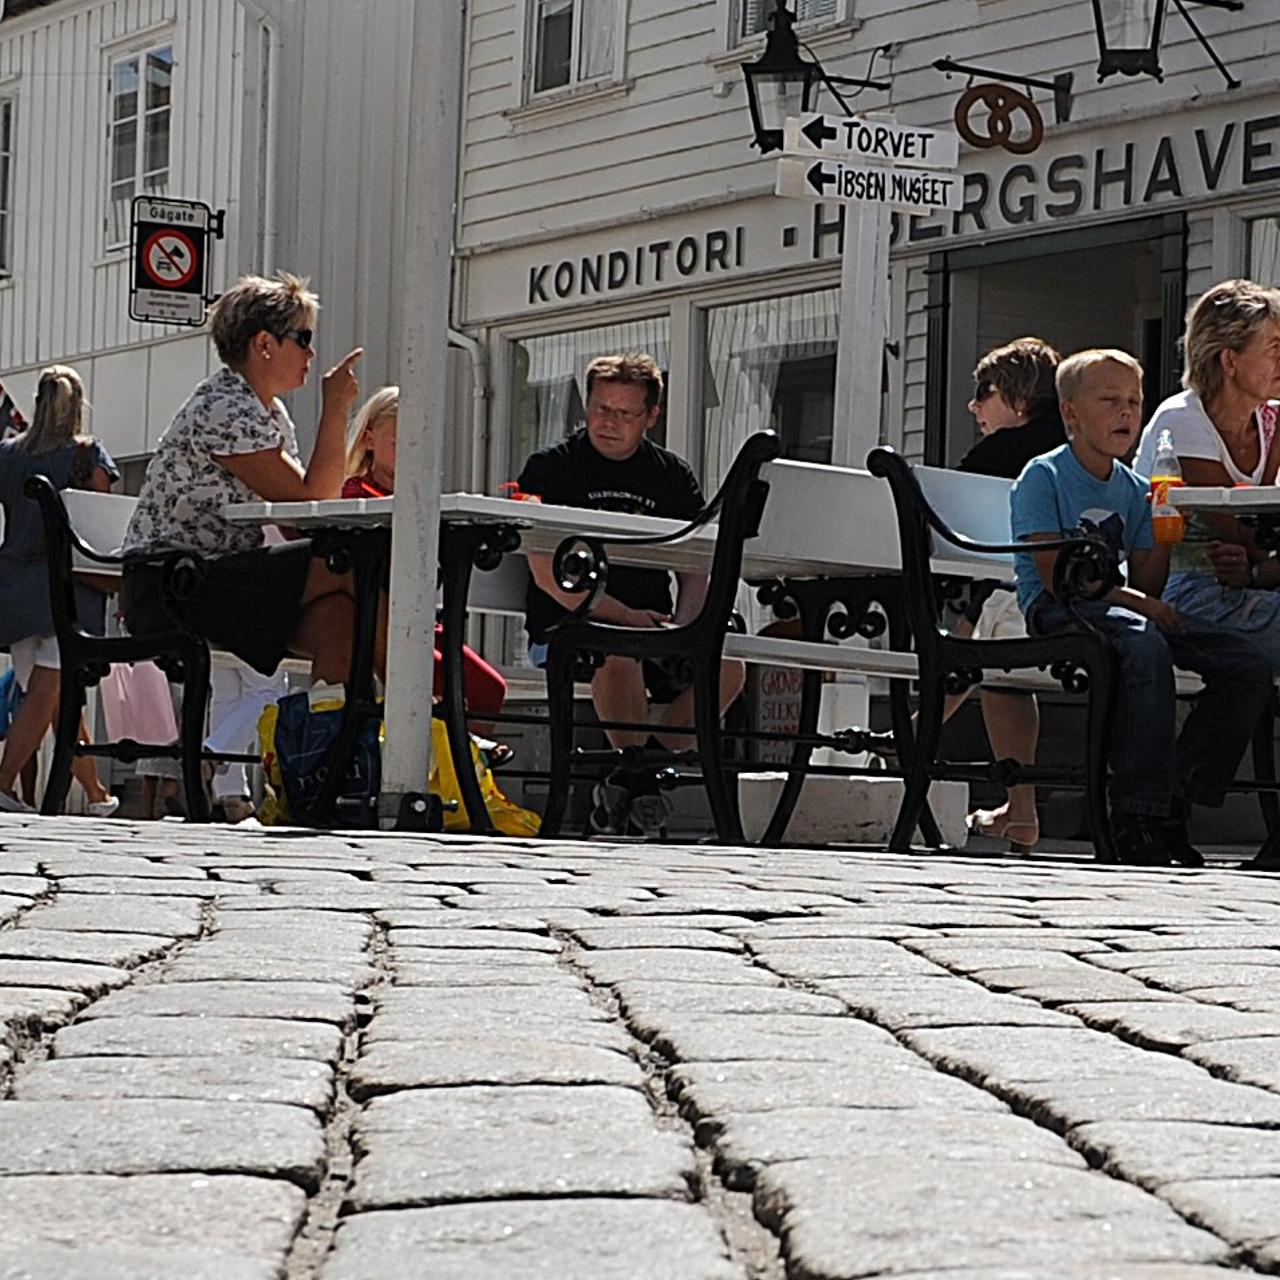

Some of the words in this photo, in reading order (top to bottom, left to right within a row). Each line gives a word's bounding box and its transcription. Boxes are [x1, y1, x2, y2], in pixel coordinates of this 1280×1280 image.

[842, 121, 935, 159] TORVET
[149, 206, 195, 222] Gågate
[528, 226, 745, 304] KONDITORI
